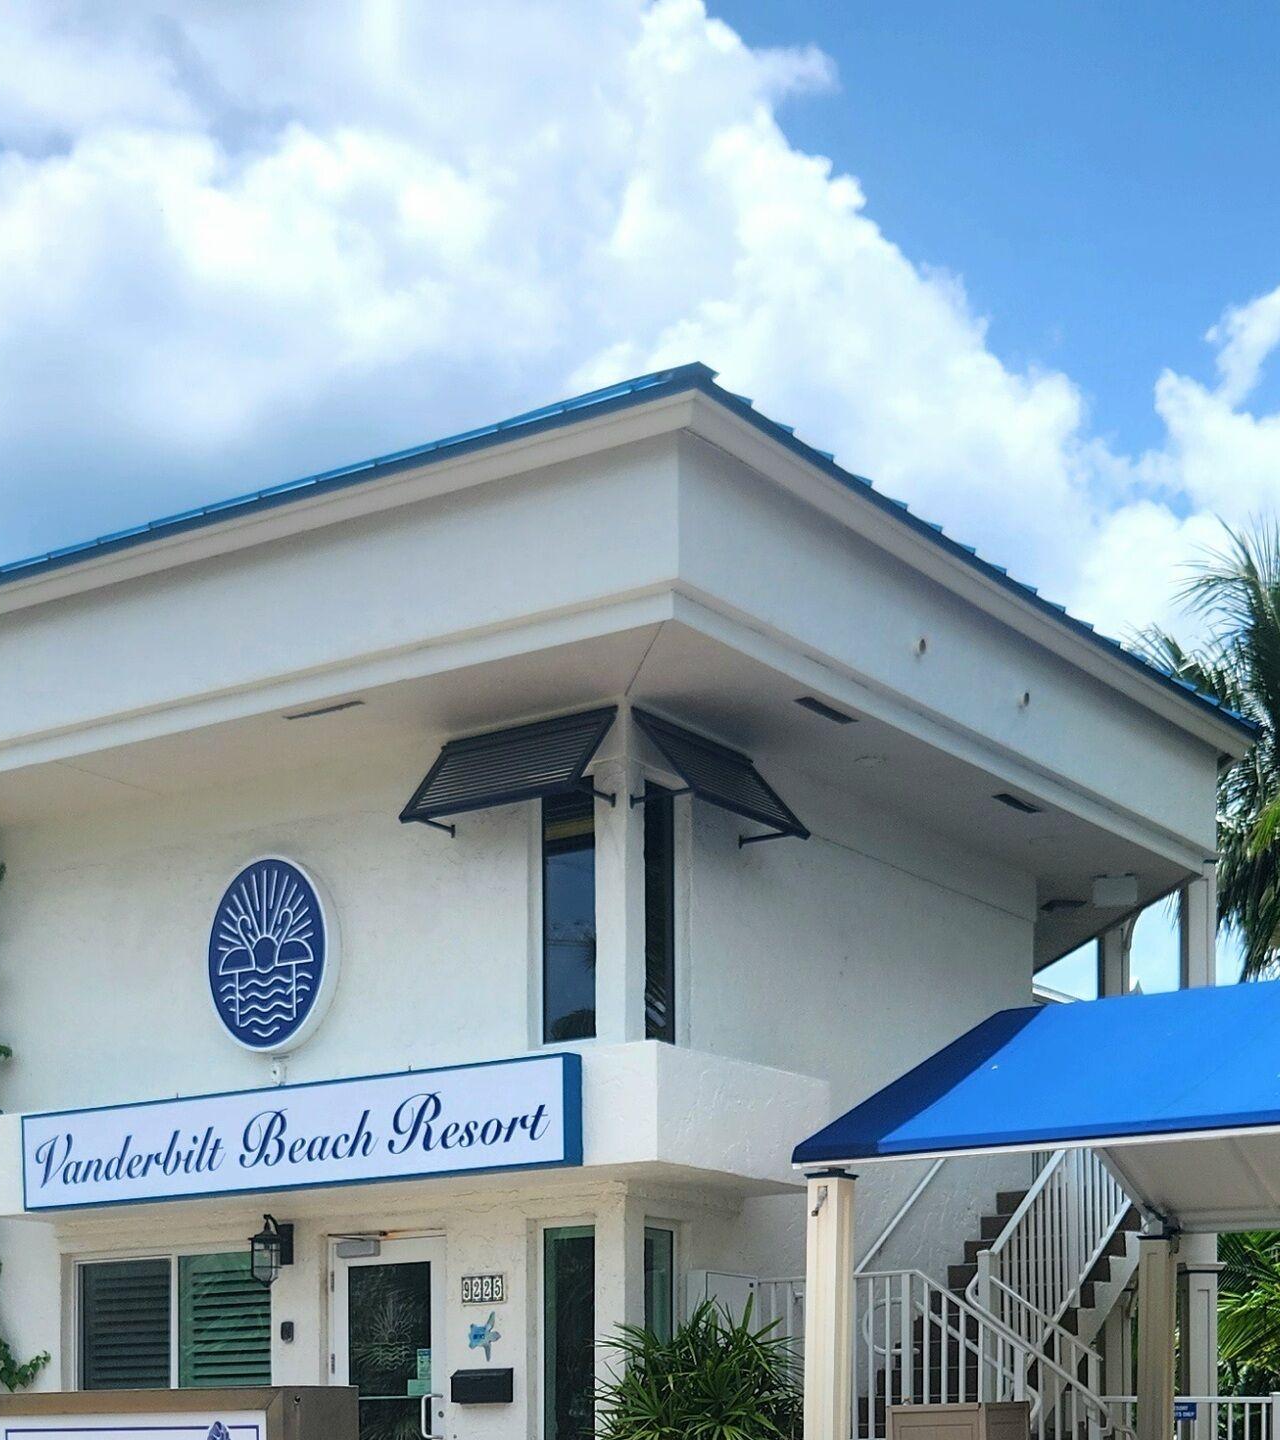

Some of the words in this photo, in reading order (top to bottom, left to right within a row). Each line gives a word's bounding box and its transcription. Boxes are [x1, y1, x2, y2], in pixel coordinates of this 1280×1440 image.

[35, 1125, 227, 1188] Vanderbilt
[240, 1108, 379, 1168] Beach
[388, 1091, 551, 1155] Resort
[463, 1279, 501, 1299] 9225
